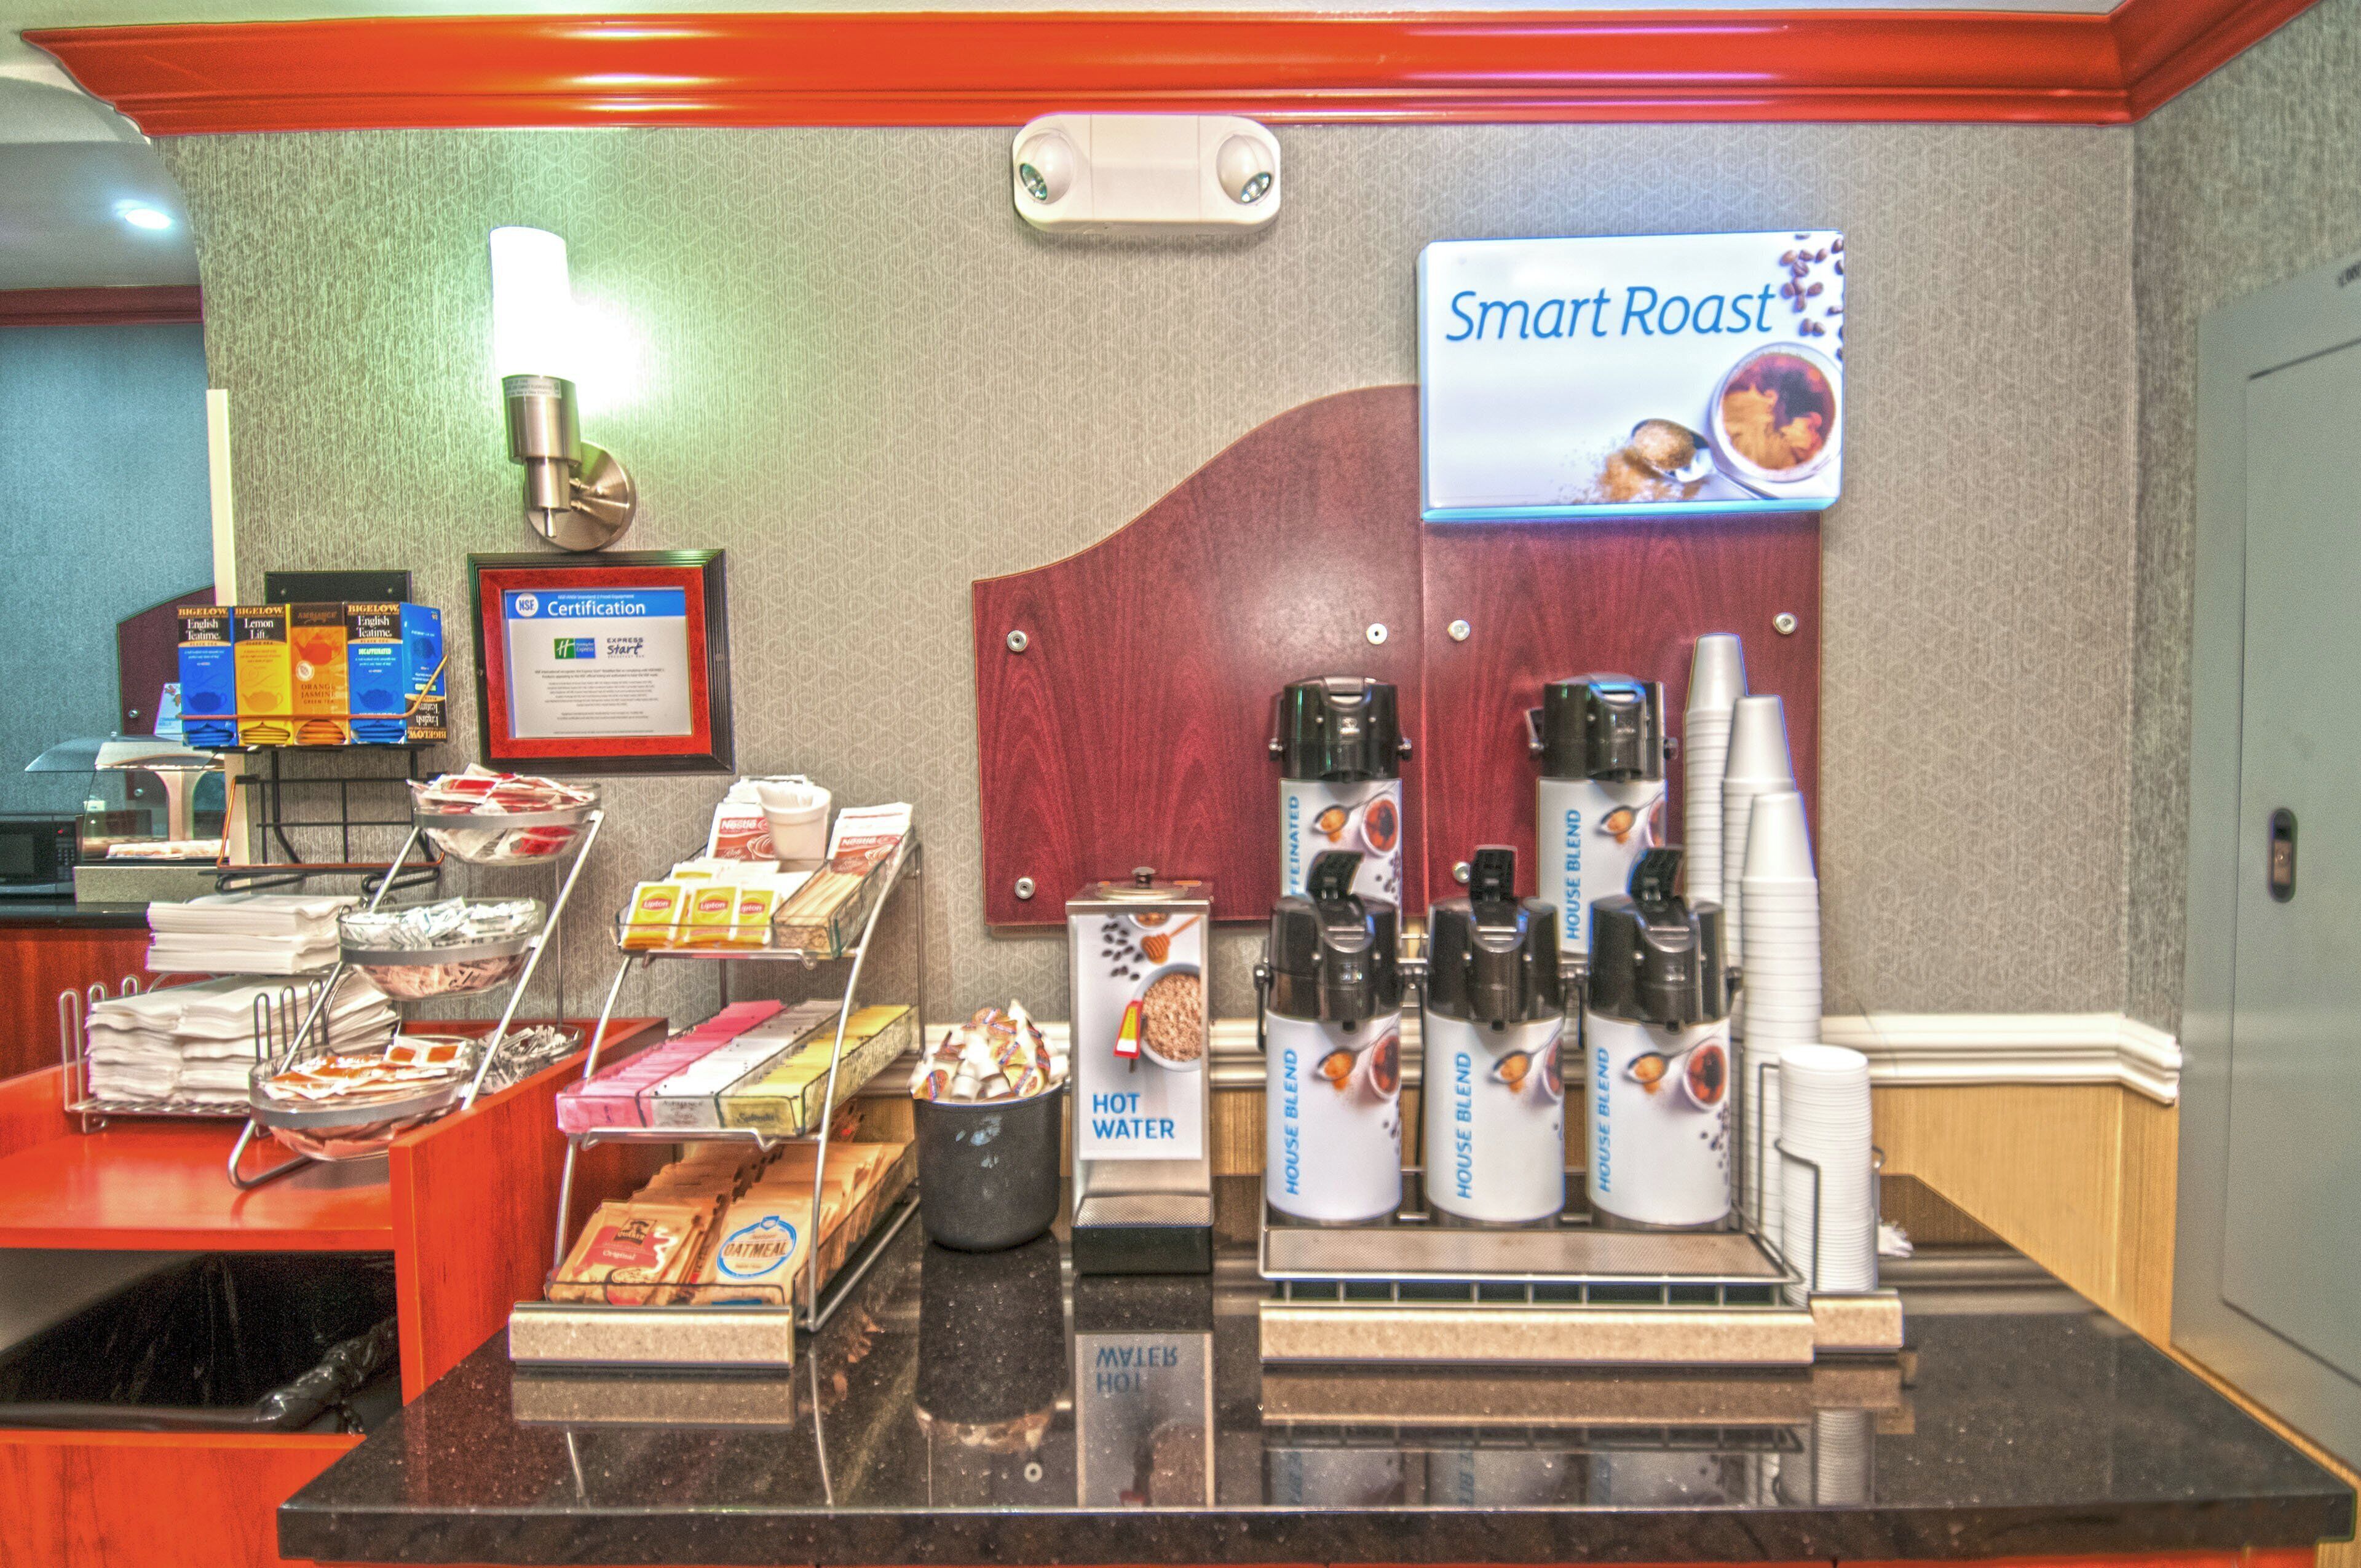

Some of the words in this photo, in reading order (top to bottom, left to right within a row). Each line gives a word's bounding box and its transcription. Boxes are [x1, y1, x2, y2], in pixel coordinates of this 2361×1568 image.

[1445, 287, 1611, 341] Smart
[1621, 283, 1776, 336] Roast
[518, 599, 535, 611] NSF
[547, 600, 646, 616] Certification
[187, 618, 218, 630] English
[244, 618, 274, 628] Lemon
[358, 615, 390, 627] English
[186, 629, 219, 640] Teatime
[250, 629, 265, 640] Lift
[357, 626, 390, 638] Teatime
[1289, 795, 1300, 896] FFEINATED
[1565, 810, 1581, 872] BLEND
[644, 900, 669, 908] Lipton
[700, 902, 726, 910] Lipton
[740, 904, 762, 913] ipton
[1565, 878, 1581, 939] HOUSE
[1283, 1049, 1299, 1119] BLEND
[1454, 1052, 1472, 1123] BLEND
[1592, 1047, 1610, 1117] BLEND
[1093, 1093, 1141, 1114] HOT
[1092, 1118, 1175, 1140] WATER
[1284, 1123, 1300, 1195] HOUSE
[1455, 1126, 1473, 1200] HOUSE
[1591, 1120, 1611, 1193] HOUSE
[723, 1242, 788, 1258] OATMEAL
